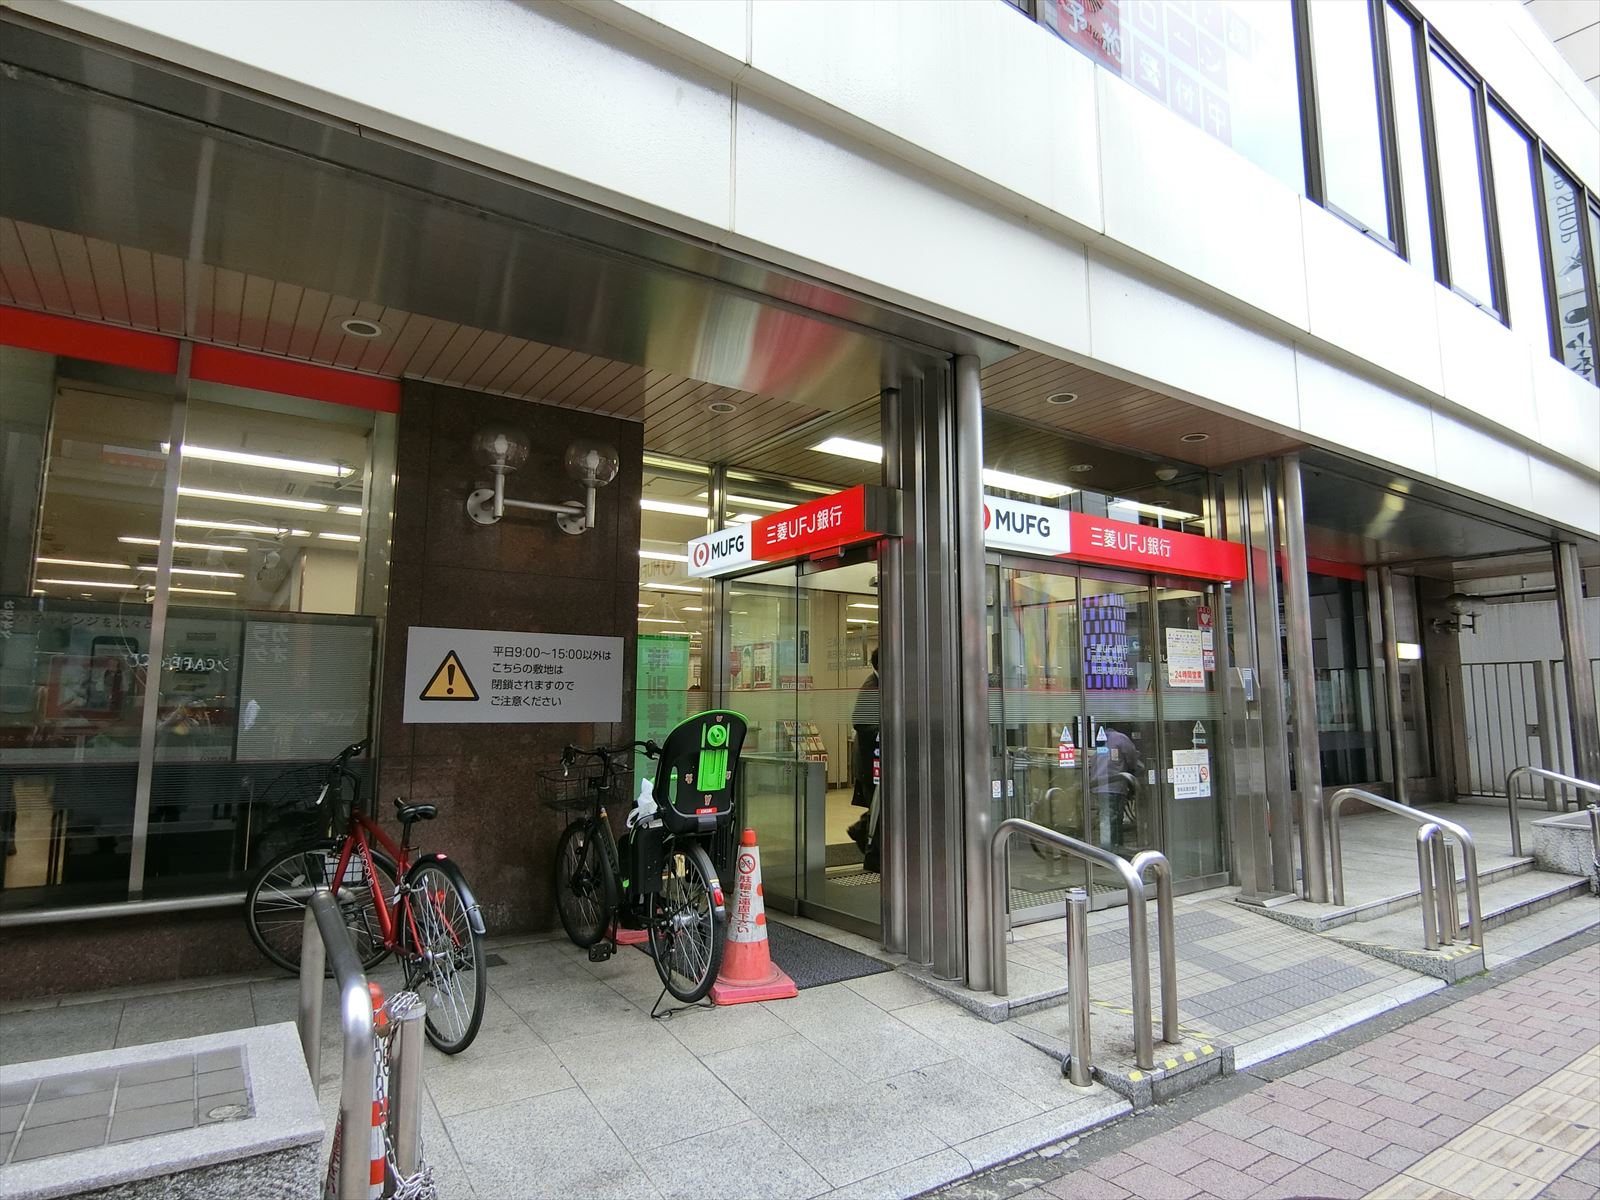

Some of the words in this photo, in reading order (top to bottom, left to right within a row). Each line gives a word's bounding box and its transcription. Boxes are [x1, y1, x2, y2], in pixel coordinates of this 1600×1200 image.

[1139, 49, 1226, 137] 受付中
[766, 505, 842, 545] 三菱UFJ銀行
[995, 508, 1051, 537] MUFG
[711, 534, 744, 560] MUFG
[1090, 527, 1171, 558] 三菱UFJ銀行
[492, 663, 564, 675] こちらの敷地は
[491, 679, 575, 691] 閉鎖されますので
[490, 695, 562, 707] ご注意ください
